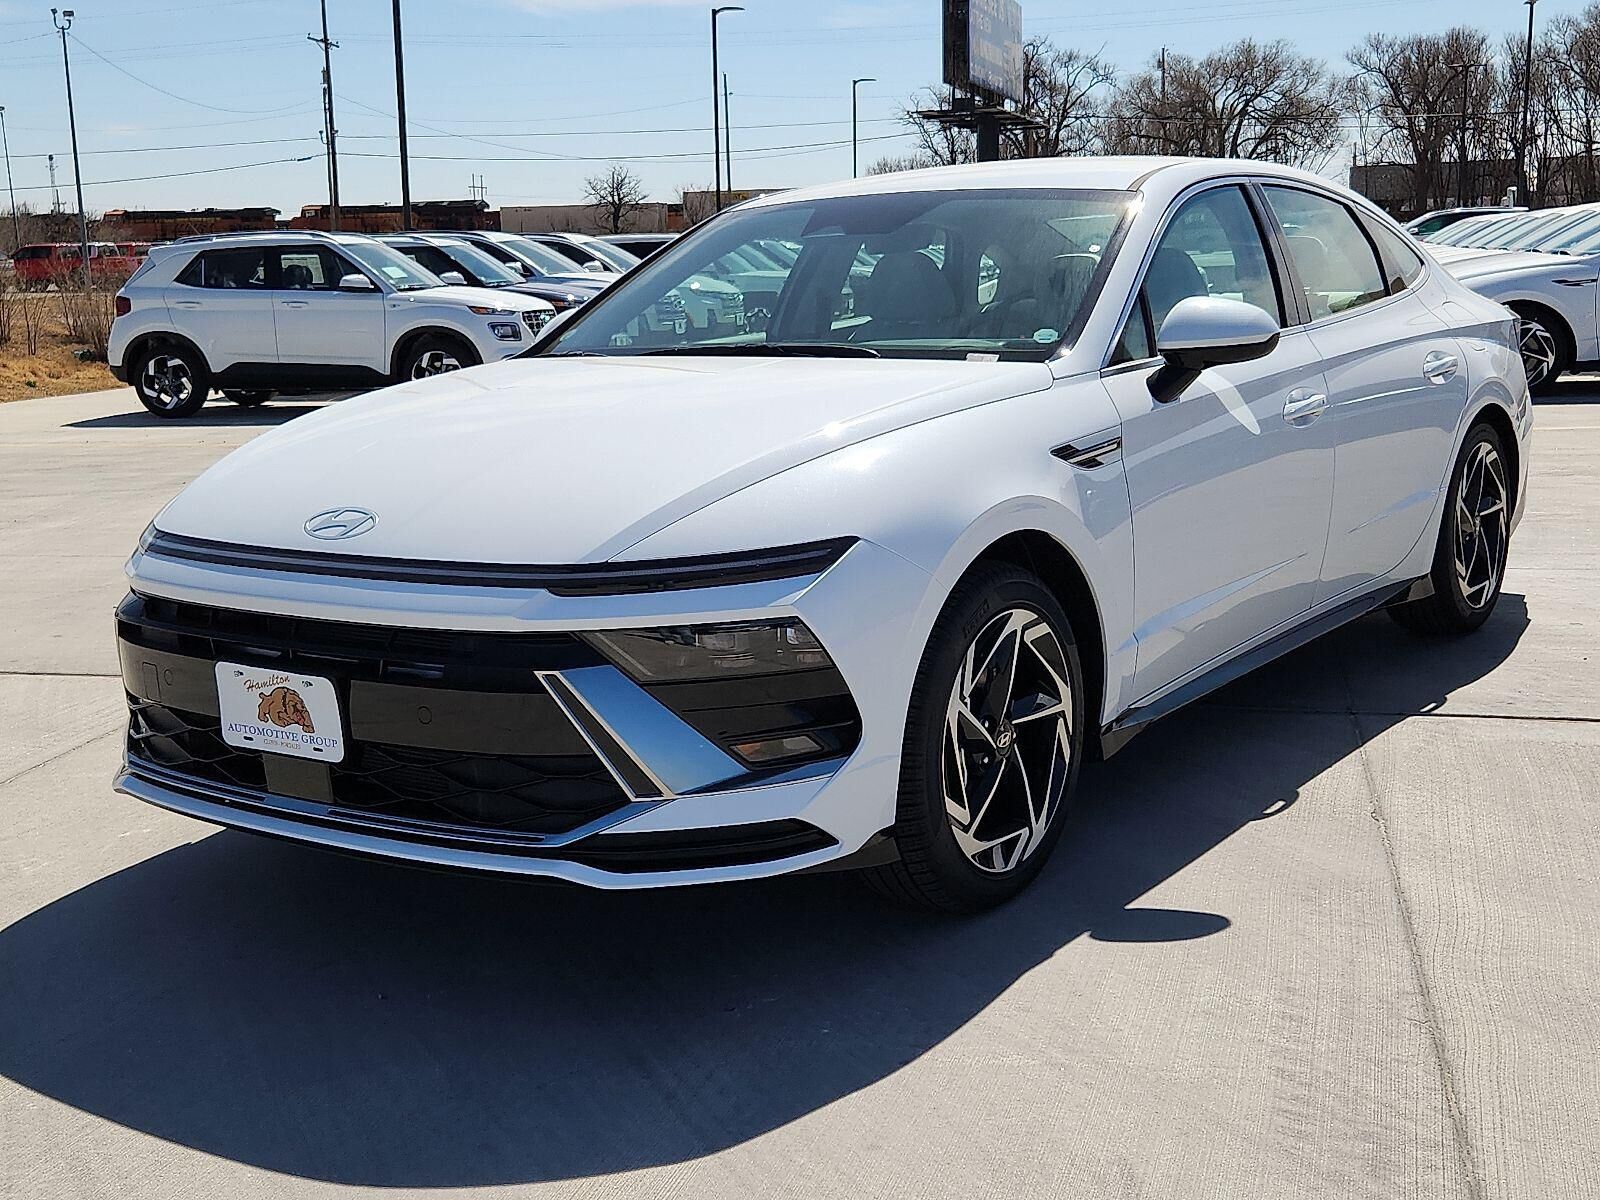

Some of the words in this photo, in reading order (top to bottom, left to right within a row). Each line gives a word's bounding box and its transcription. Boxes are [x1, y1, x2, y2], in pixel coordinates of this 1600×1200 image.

[243, 674, 291, 693] Hamilton
[228, 722, 299, 742] AUTOMOTIVE
[301, 734, 338, 748] GROUP
